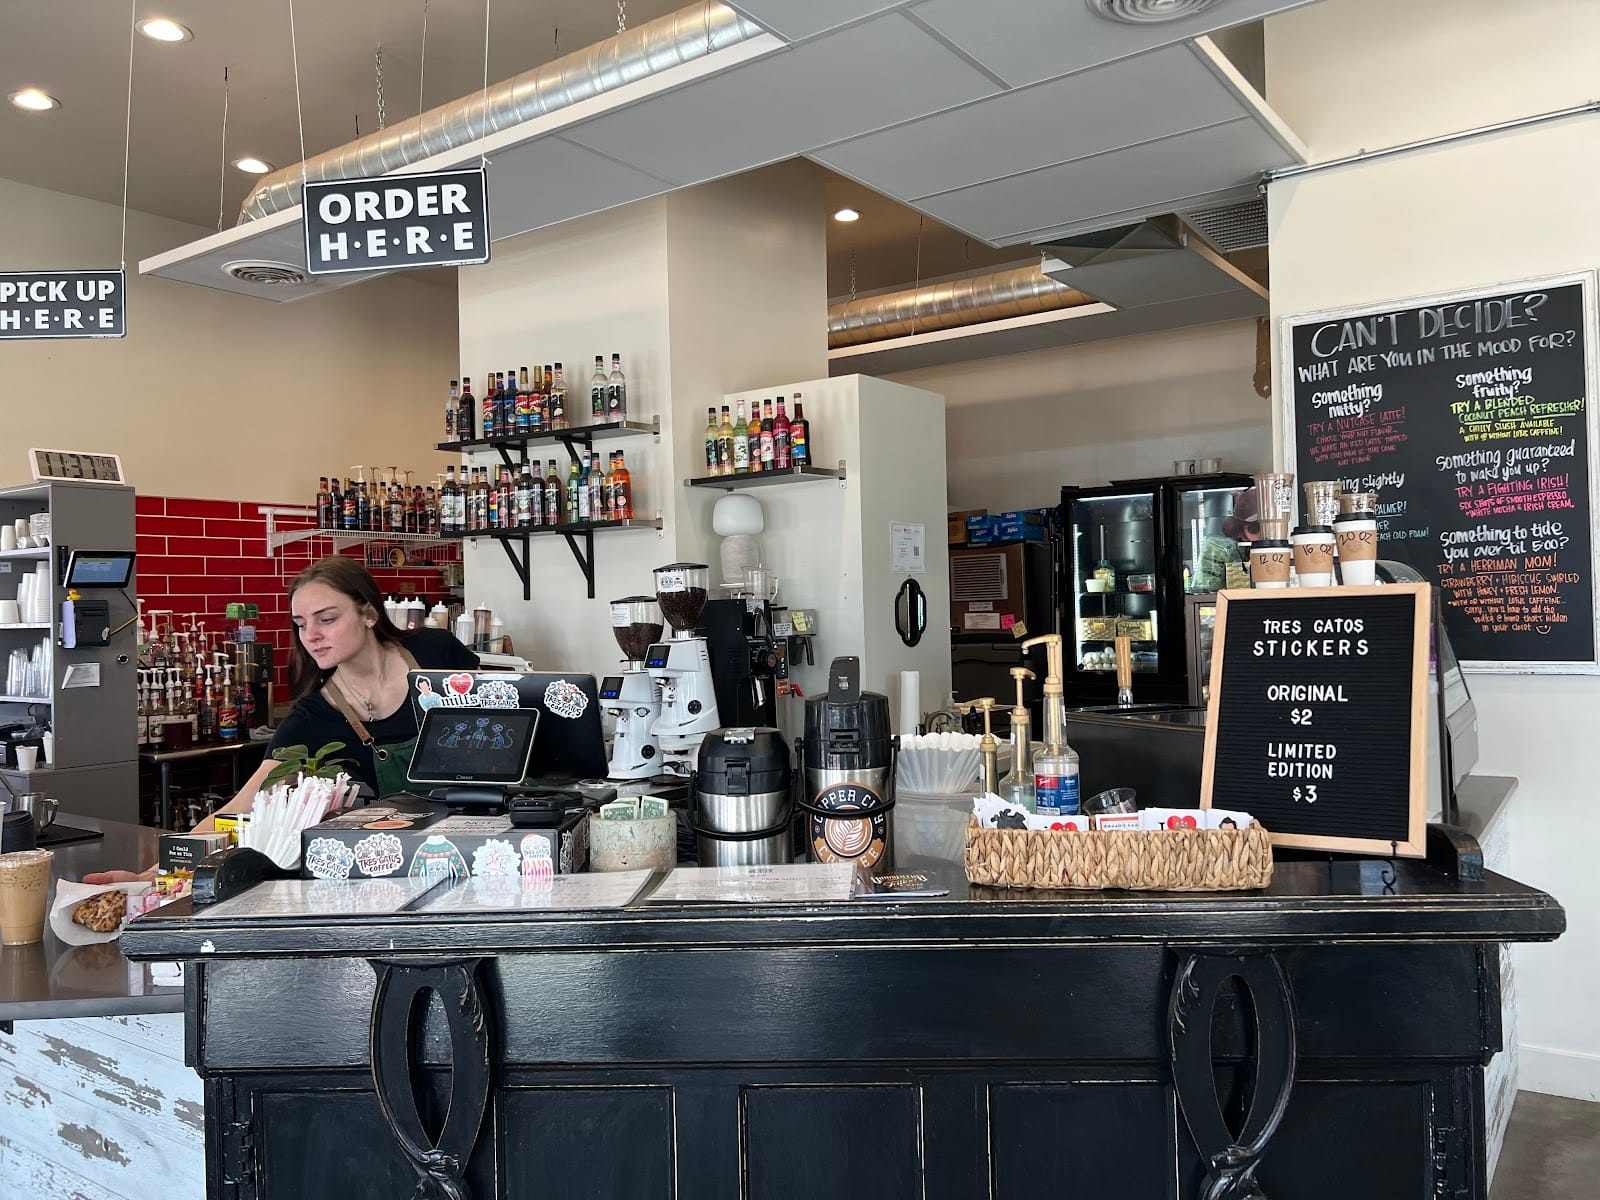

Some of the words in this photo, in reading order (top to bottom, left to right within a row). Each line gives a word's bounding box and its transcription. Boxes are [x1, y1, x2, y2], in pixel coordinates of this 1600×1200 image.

[318, 184, 472, 224] ORDER
[0, 280, 68, 302] PICK
[76, 280, 115, 302] UP
[1310, 312, 1407, 358] CAN'T
[1419, 293, 1548, 338] DECIDE?
[1298, 360, 1338, 382] WHAT
[1348, 354, 1378, 374] ARE
[1380, 350, 1412, 368] YOU
[1417, 348, 1435, 365] IN
[1440, 342, 1472, 360] THE
[1478, 338, 1522, 356] MOOD
[1529, 330, 1576, 352] FOR?
[1456, 366, 1532, 388] Something
[1312, 383, 1383, 408] Something
[1472, 380, 1520, 398] fruity?
[1329, 399, 1370, 418] nutty?
[1450, 400, 1470, 414] TRY
[1474, 400, 1480, 410] A
[1485, 395, 1535, 410] BLENDED
[1459, 410, 1494, 423] COCONUT
[1498, 407, 1527, 418] PEACH
[1530, 397, 1584, 415] REFRESHER!
[1306, 422, 1324, 436] TRY
[1328, 423, 1332, 432] A
[1336, 413, 1376, 430] NUTCASE
[1494, 422, 1516, 430] SLUSH
[1520, 419, 1554, 428] AVAILABLE
[1436, 450, 1500, 472] Something
[1506, 439, 1576, 466] guaranteed
[1362, 471, 1404, 490] slightly
[1456, 470, 1466, 484] to
[1470, 464, 1498, 482] wake
[1502, 464, 1520, 481] you
[1526, 458, 1550, 476] up?
[1454, 485, 1473, 498] TRY
[1478, 485, 1484, 494] A
[1488, 480, 1533, 495] FIGHTING
[1537, 473, 1568, 489] IRISH!
[1460, 501, 1472, 510] SIX
[1506, 494, 1532, 504] SMOOTH
[1533, 490, 1566, 502] ESPRESSO
[1493, 504, 1516, 514] MOCHA
[1523, 502, 1544, 512] IRISH
[1340, 532, 1355, 546] 20
[1359, 531, 1372, 544] OZ
[1440, 524, 1510, 547] Something
[1512, 525, 1528, 540] to
[1530, 520, 1563, 538] tide
[1260, 554, 1268, 564] 12
[1302, 544, 1314, 556] 16
[1444, 547, 1470, 563] you
[1474, 545, 1504, 557] over
[1437, 564, 1454, 574] TRY
[1460, 563, 1466, 572] A
[1470, 558, 1518, 572] HERRIMAN
[1524, 552, 1558, 569] MOM!
[1440, 575, 1492, 588] STRAWBERRY
[1502, 574, 1542, 586] HIBISCUS
[1546, 573, 1580, 584] SWIRLED
[1453, 589, 1472, 599] WITH
[1477, 586, 1498, 596] HONEY
[1505, 586, 1528, 595] FRESH
[1263, 619, 1301, 634] TRES
[1313, 618, 1364, 634] GATOS
[1252, 640, 1368, 656] STICKERS
[1267, 684, 1348, 702] ORIGINAL
[1290, 708, 1312, 725] $2
[1268, 743, 1336, 760] LIMITED
[1268, 762, 1333, 779] EDITION
[814, 789, 856, 824] CPPER
[308, 855, 325, 867] TRES
[358, 858, 377, 872] TRES
[818, 846, 878, 867] COEE
